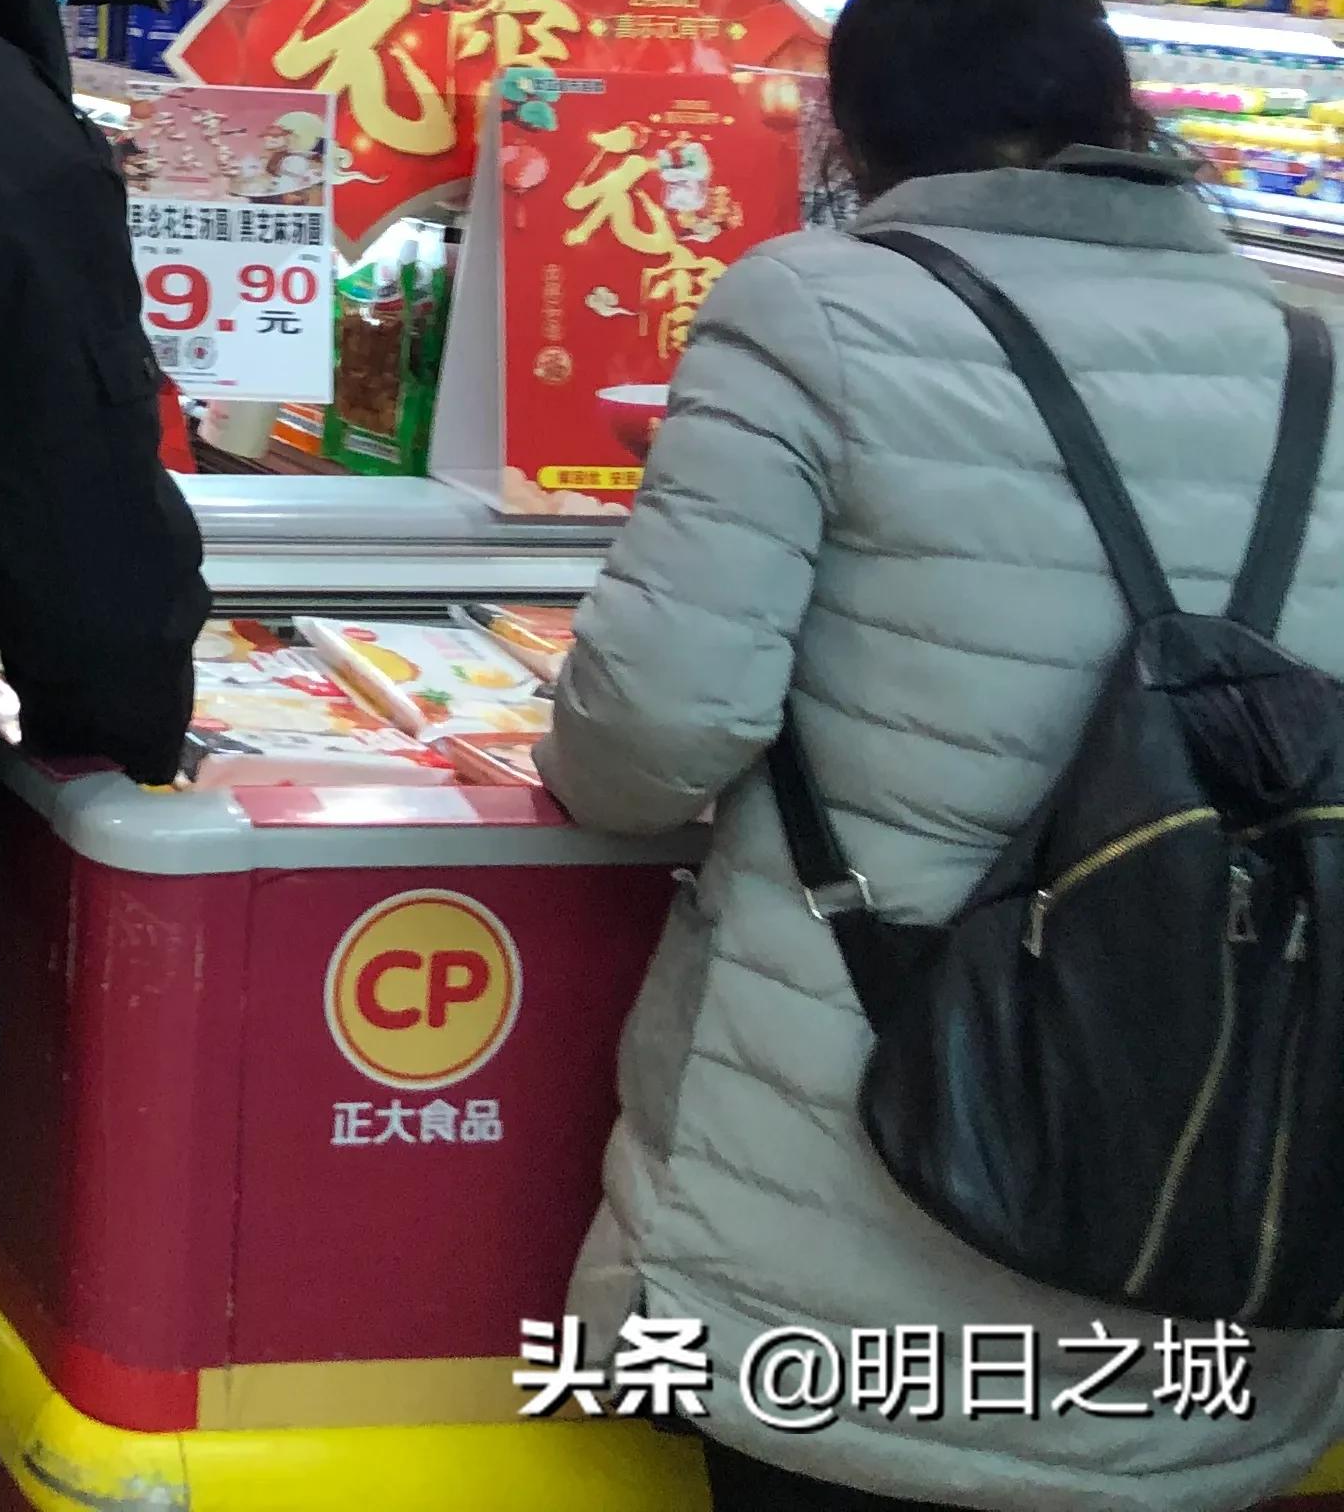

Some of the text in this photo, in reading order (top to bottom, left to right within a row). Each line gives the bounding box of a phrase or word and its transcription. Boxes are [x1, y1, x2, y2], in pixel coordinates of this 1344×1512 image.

[256, 309, 302, 335] 元
[356, 949, 492, 1030] CP
[330, 1098, 506, 1145] 正大食品
